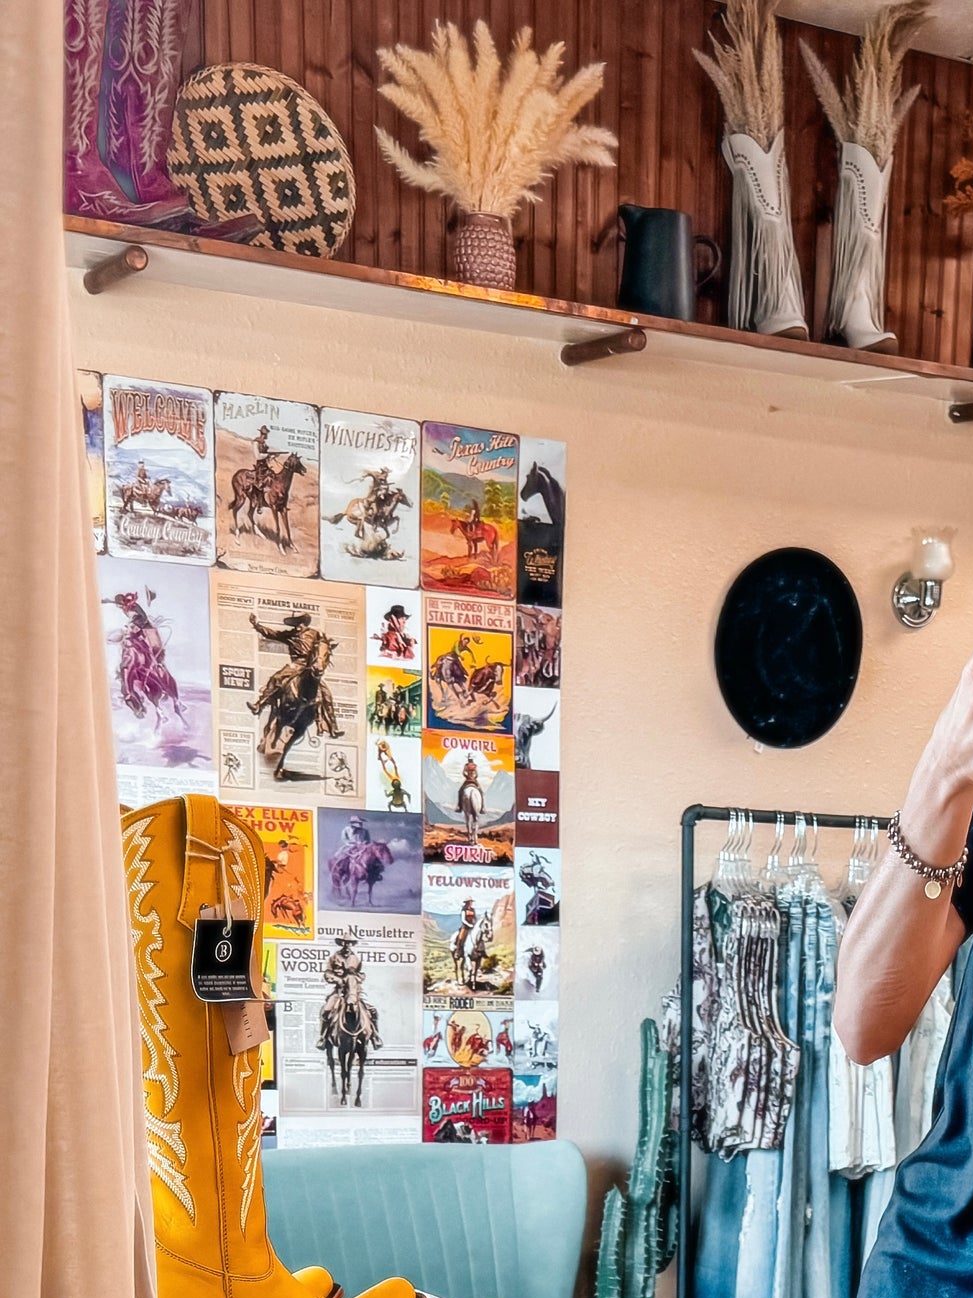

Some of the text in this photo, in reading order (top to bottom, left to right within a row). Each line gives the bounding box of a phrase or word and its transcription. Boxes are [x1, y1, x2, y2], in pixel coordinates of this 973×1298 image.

[110, 388, 206, 458] WELCOME
[324, 424, 417, 456] WINCHESTER
[447, 434, 516, 461] Texas Hill
[467, 455, 515, 476] Country
[121, 514, 203, 550] Cowboy Country
[258, 598, 320, 612] FARMERS MARKET
[454, 602, 483, 613] RODEO
[429, 611, 483, 626] STATE FAIR
[507, 620, 512, 629] 1
[222, 667, 251, 678] SPORT
[223, 676, 250, 688] NEWS
[443, 737, 497, 752] COWGIRL
[262, 808, 309, 822] ELLAS
[518, 811, 558, 823] COWBOY
[245, 819, 295, 833] HOW
[445, 845, 492, 863] SPIRIT
[427, 875, 510, 889] YELLOWSTONE
[317, 924, 415, 940] own Newsletter
[280, 948, 417, 964] GOSSIP THE OLD
[281, 961, 328, 973] WORL
[449, 997, 474, 1009] RODEO
[429, 1091, 505, 1124] BLACK HILLS
